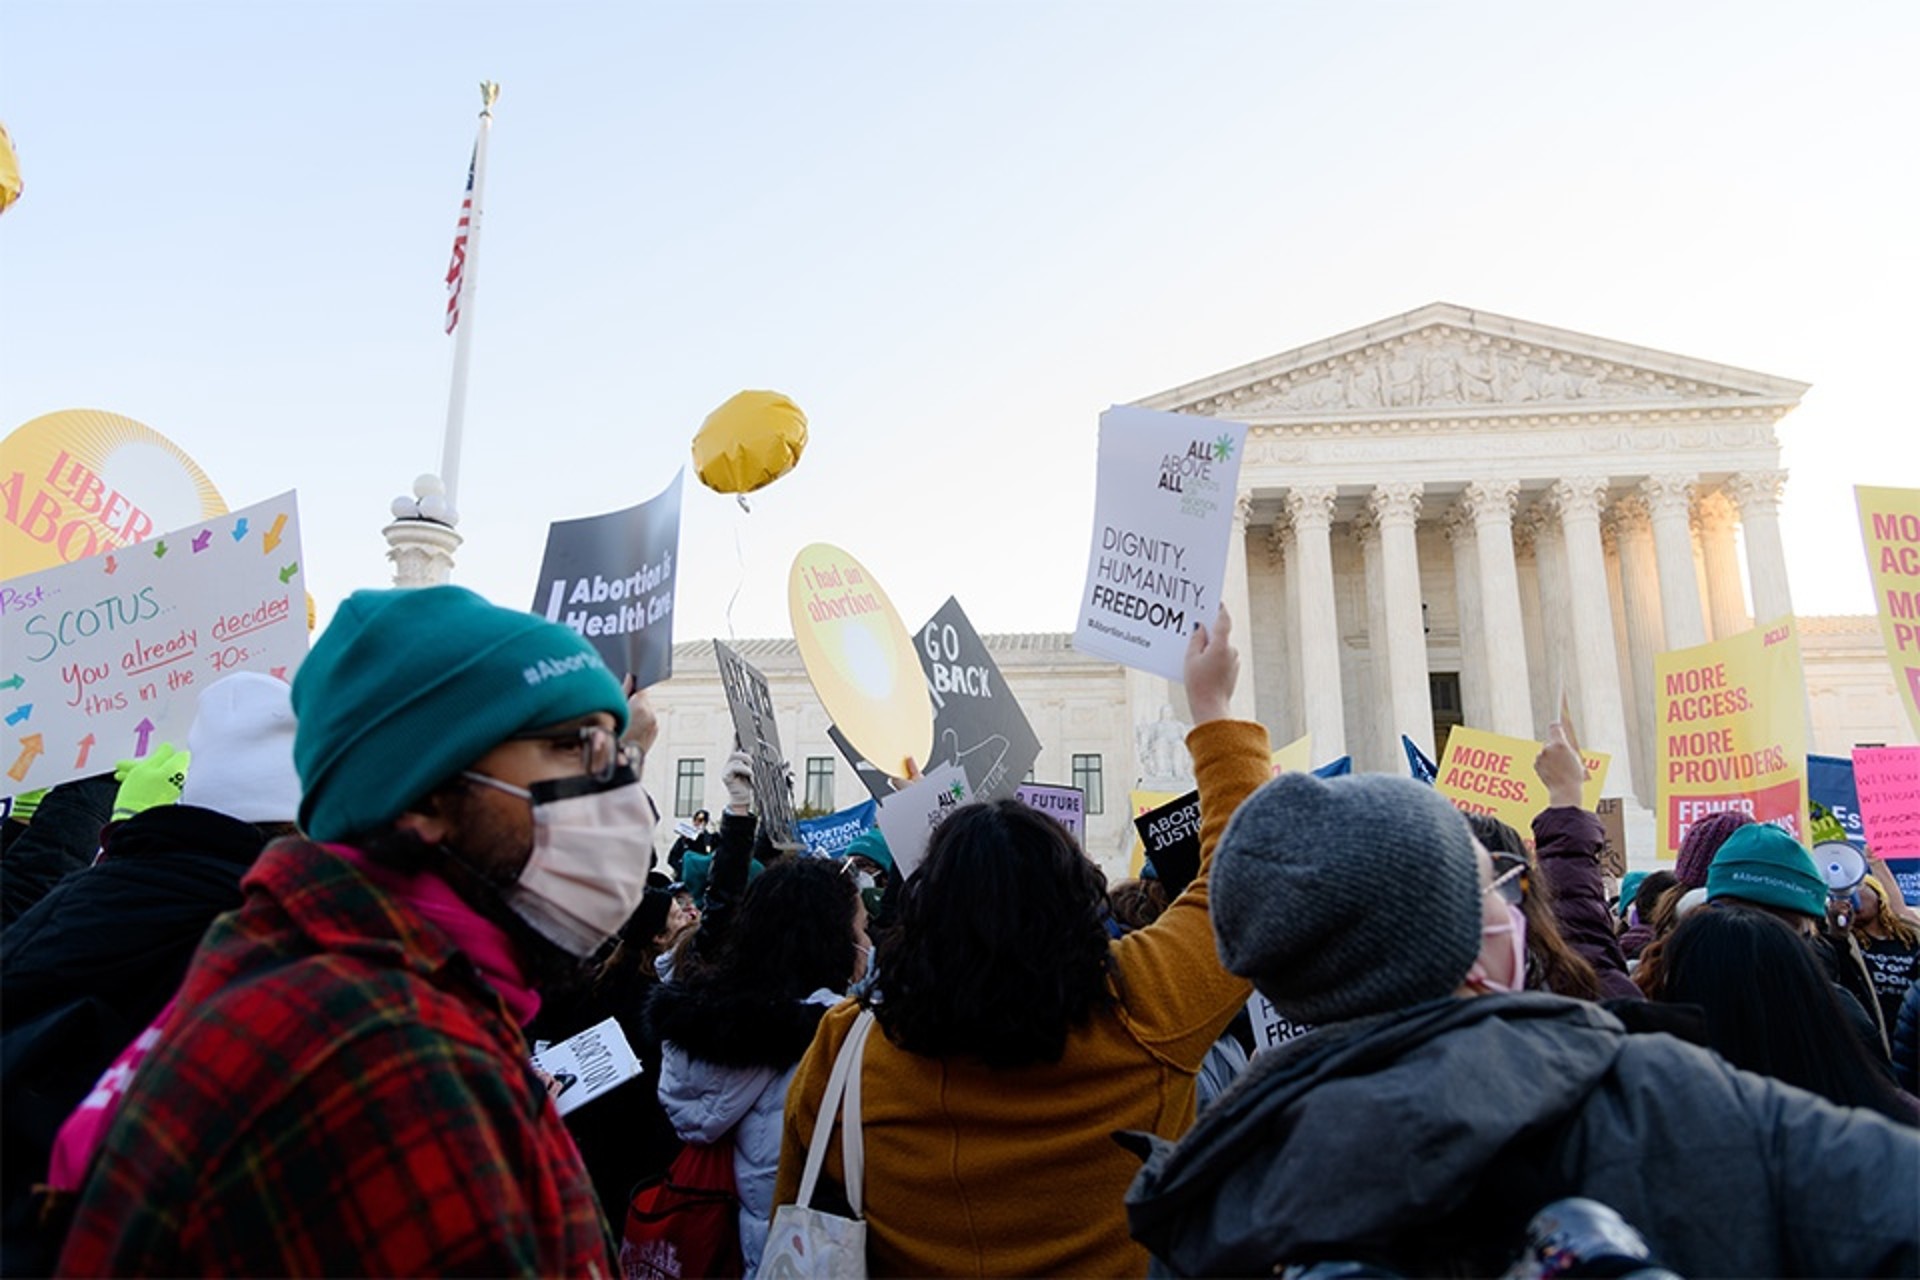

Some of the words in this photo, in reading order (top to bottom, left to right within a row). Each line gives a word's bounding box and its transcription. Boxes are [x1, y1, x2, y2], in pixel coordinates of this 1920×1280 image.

[1159, 454, 1212, 481] ABOVE
[1186, 440, 1212, 461] ALL
[1158, 472, 1183, 493] ALL
[1102, 526, 1188, 572] DIGNITY.
[568, 564, 661, 605] Abortion
[662, 550, 671, 581] is
[801, 566, 813, 590] i
[811, 563, 843, 589] had
[844, 568, 864, 585] an
[1098, 556, 1206, 610] HUMANITY.
[565, 601, 645, 637] Health
[808, 588, 882, 623] abortion.
[1091, 585, 1188, 637] FREEDOM.
[121, 629, 197, 670] already
[211, 595, 290, 640] decided
[924, 621, 959, 662] GO
[1763, 625, 1790, 647] ACLU
[85, 692, 128, 716] this
[139, 683, 157, 701] in
[167, 670, 194, 691] the
[933, 663, 992, 698] BACK
[1666, 664, 1727, 696] MORE
[1667, 687, 1753, 723] ACCESS.
[1452, 745, 1513, 776] MORE
[1669, 729, 1734, 758] MORE
[1669, 745, 1788, 784] PROVIDERS.
[1031, 793, 1080, 812] FUTURE
[1444, 767, 1529, 804] ACCESS.
